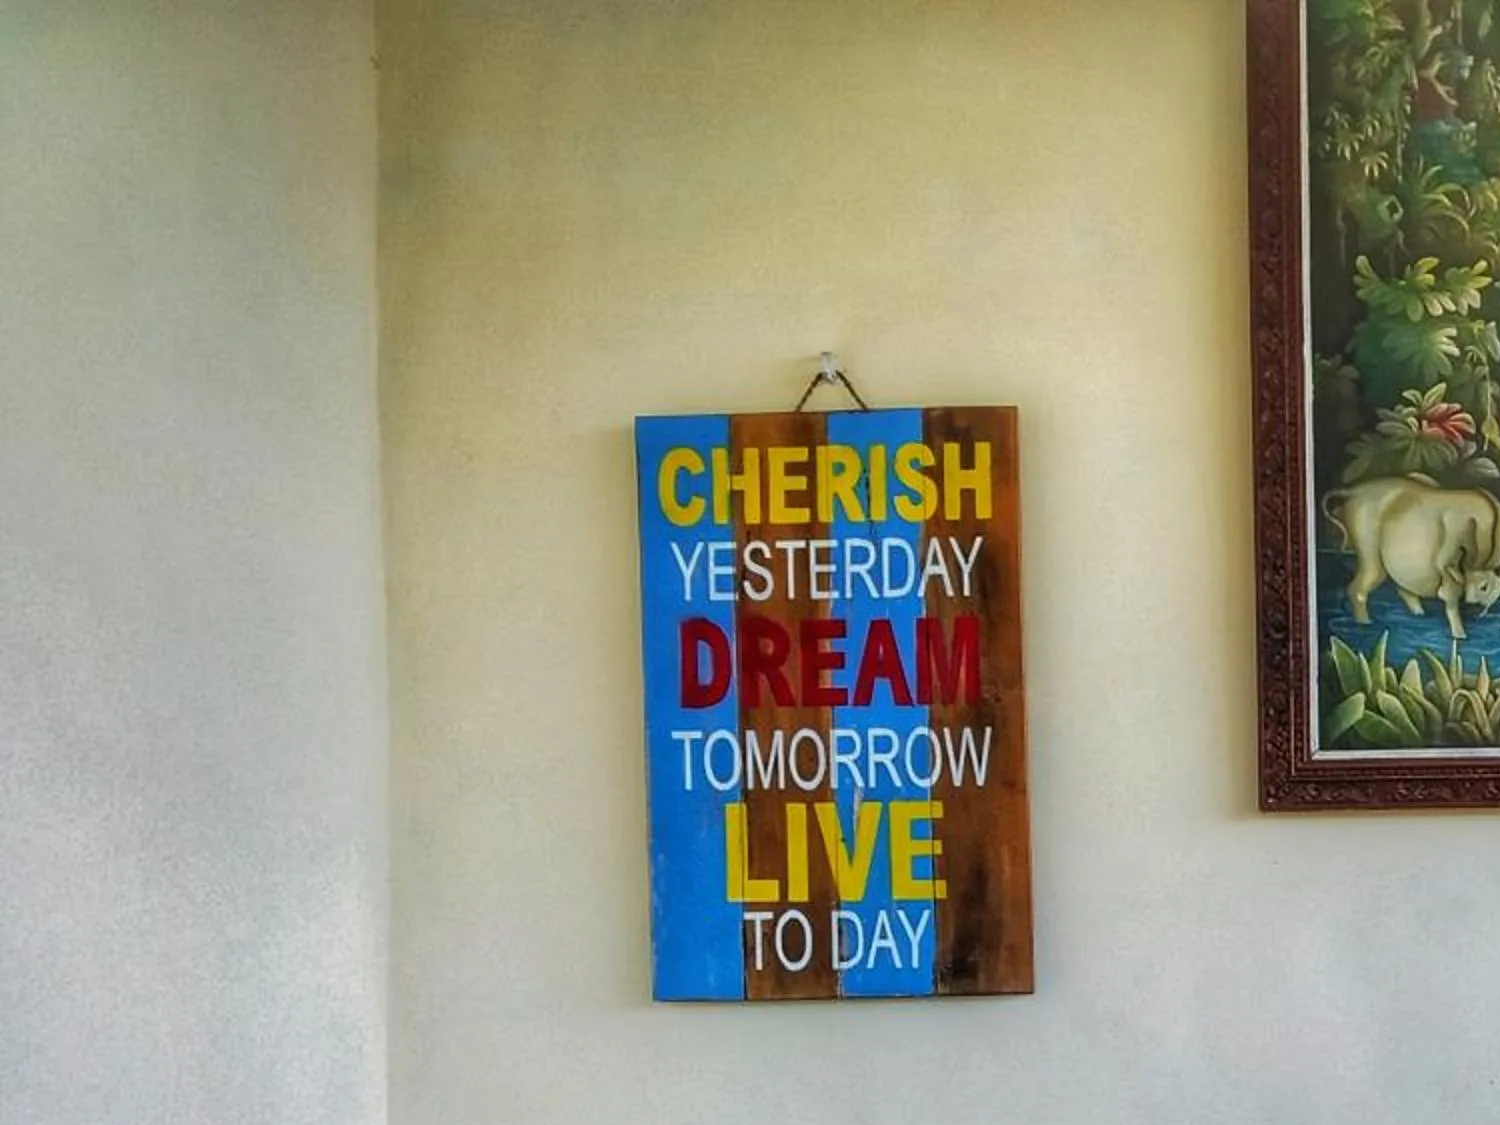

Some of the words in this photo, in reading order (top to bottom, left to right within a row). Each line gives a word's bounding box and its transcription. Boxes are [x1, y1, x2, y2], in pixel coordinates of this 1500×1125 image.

[657, 442, 992, 528] CHERISH
[670, 536, 984, 601] YESTERDAY
[679, 615, 982, 709] DREAM
[671, 726, 992, 791] TOMORROW
[724, 800, 948, 903] LIVE
[743, 910, 814, 972] TO
[832, 908, 932, 971] DAY
